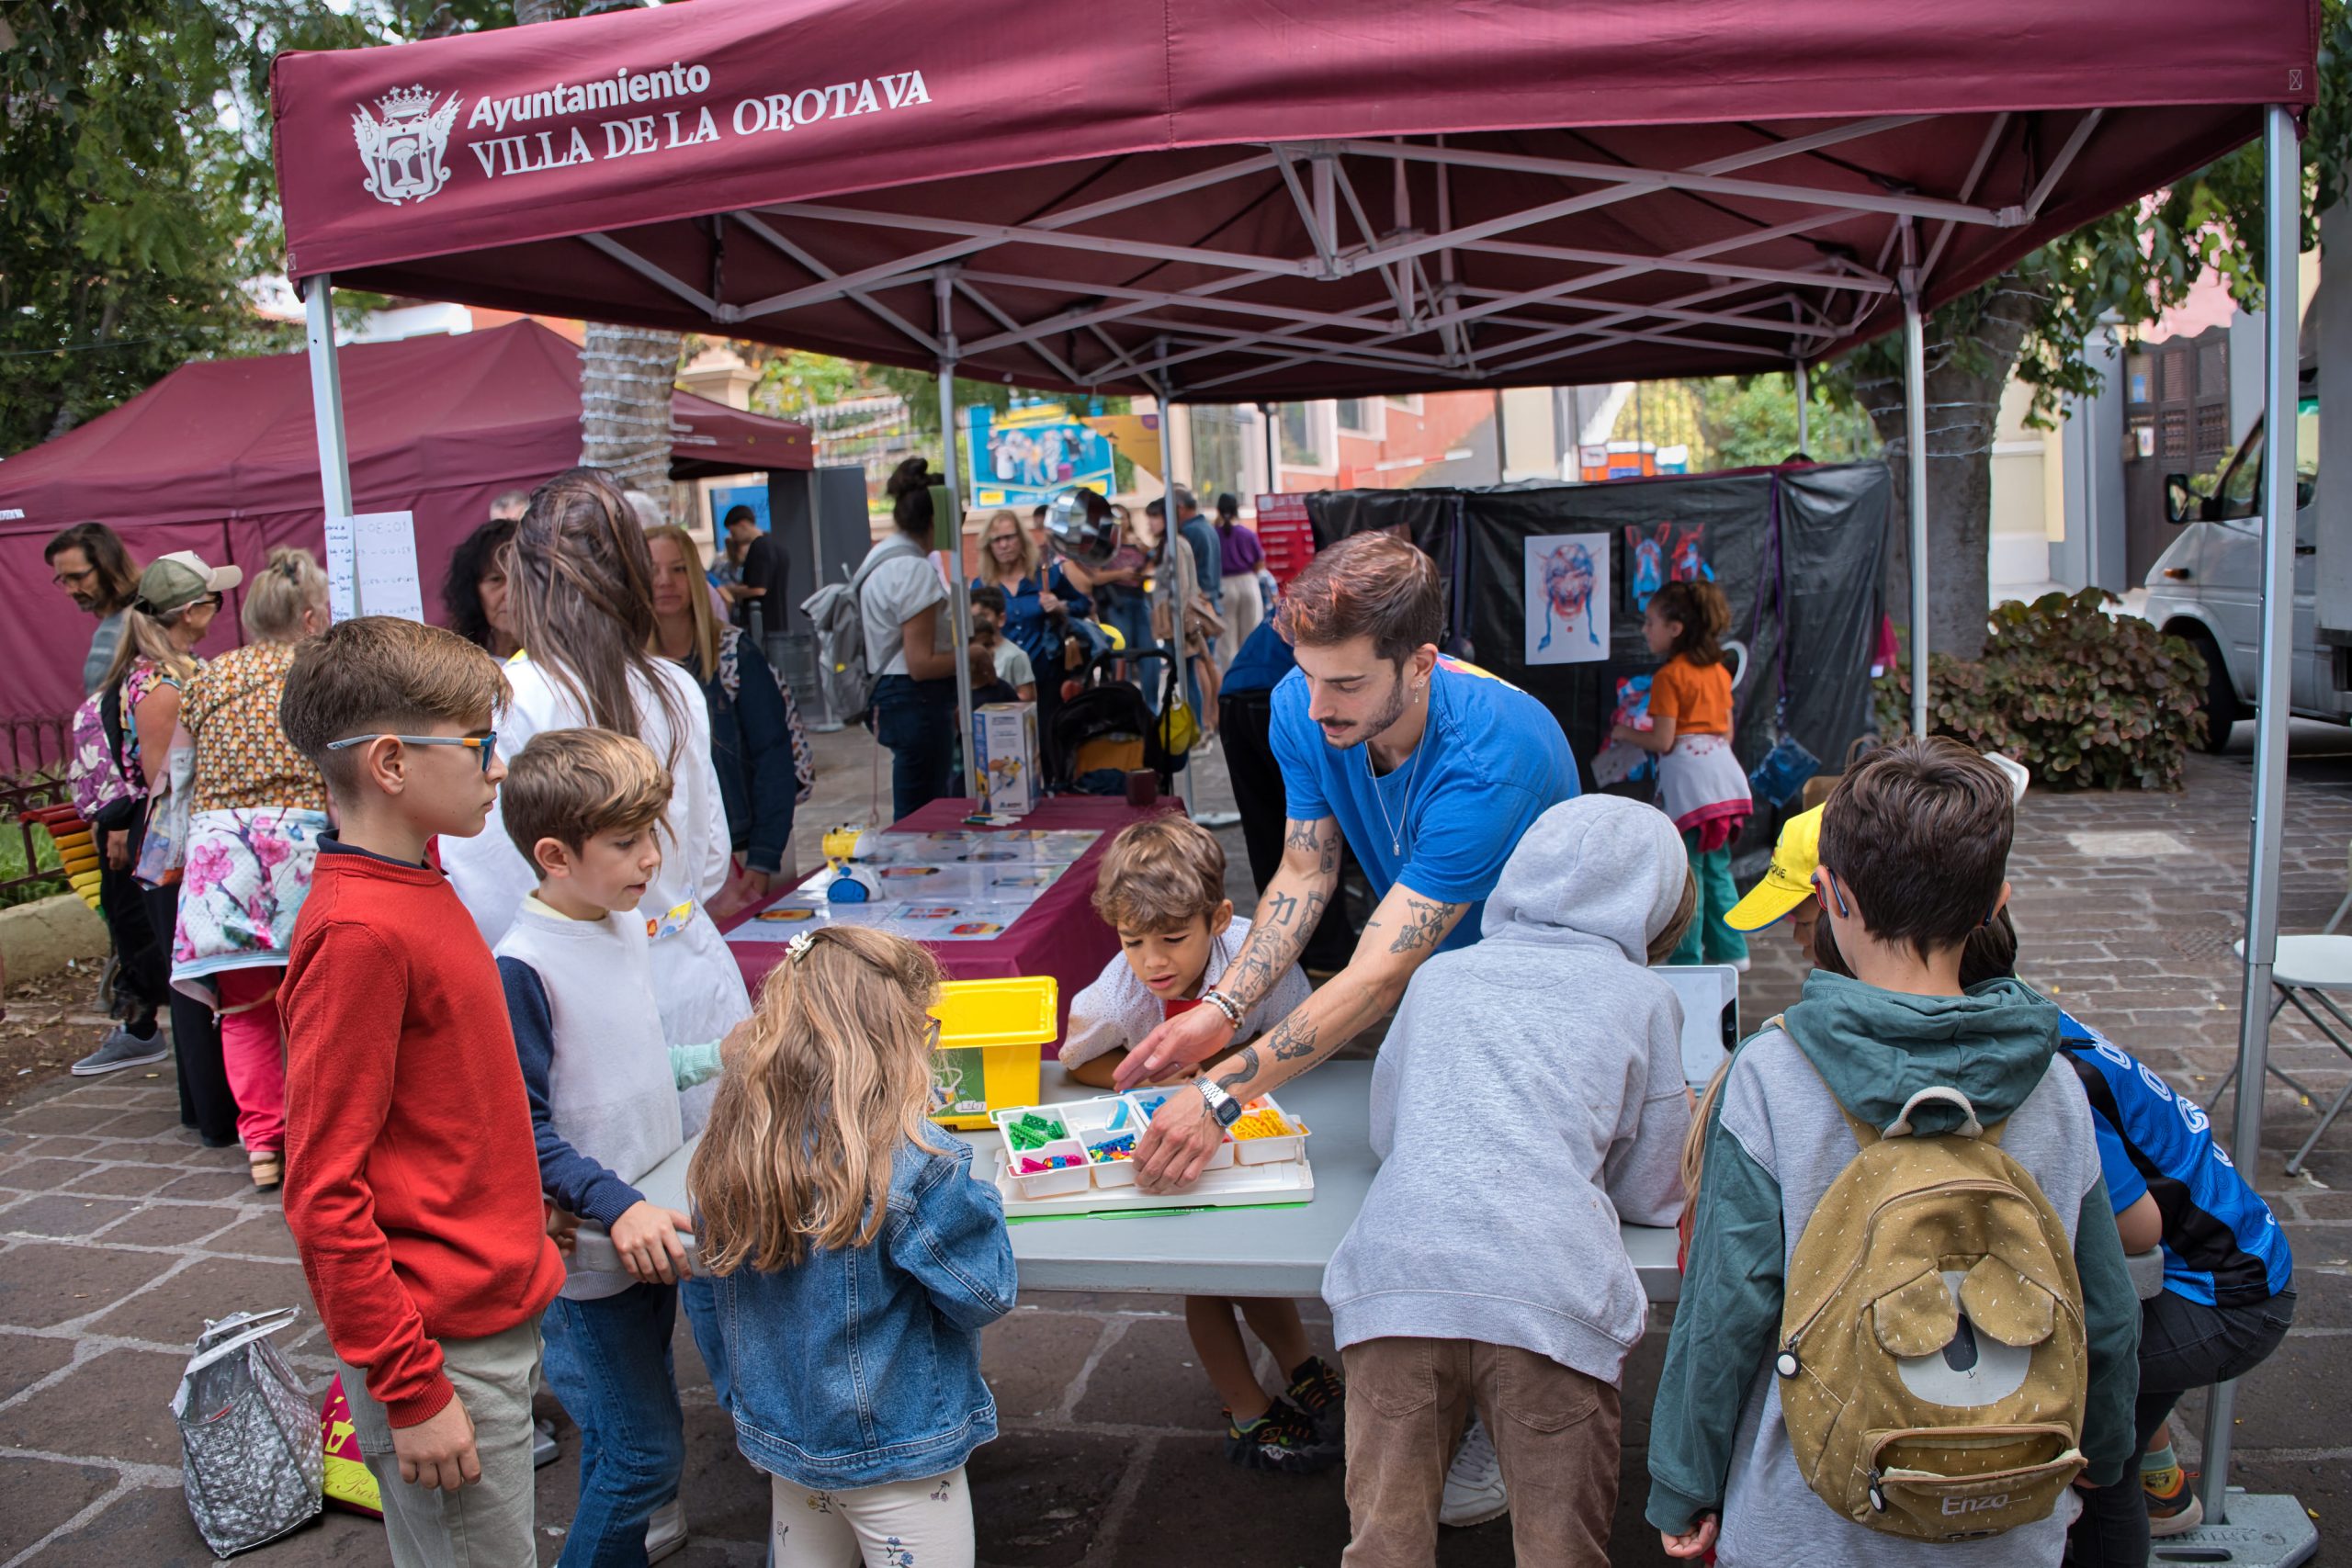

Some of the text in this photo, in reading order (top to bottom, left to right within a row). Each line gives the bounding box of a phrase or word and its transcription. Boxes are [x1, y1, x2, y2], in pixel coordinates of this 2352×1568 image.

[467, 62, 711, 132] Ayuntamiento
[468, 70, 933, 178] VILLA DE LA OROTAVA
[1940, 1494, 2009, 1516] Enzo
